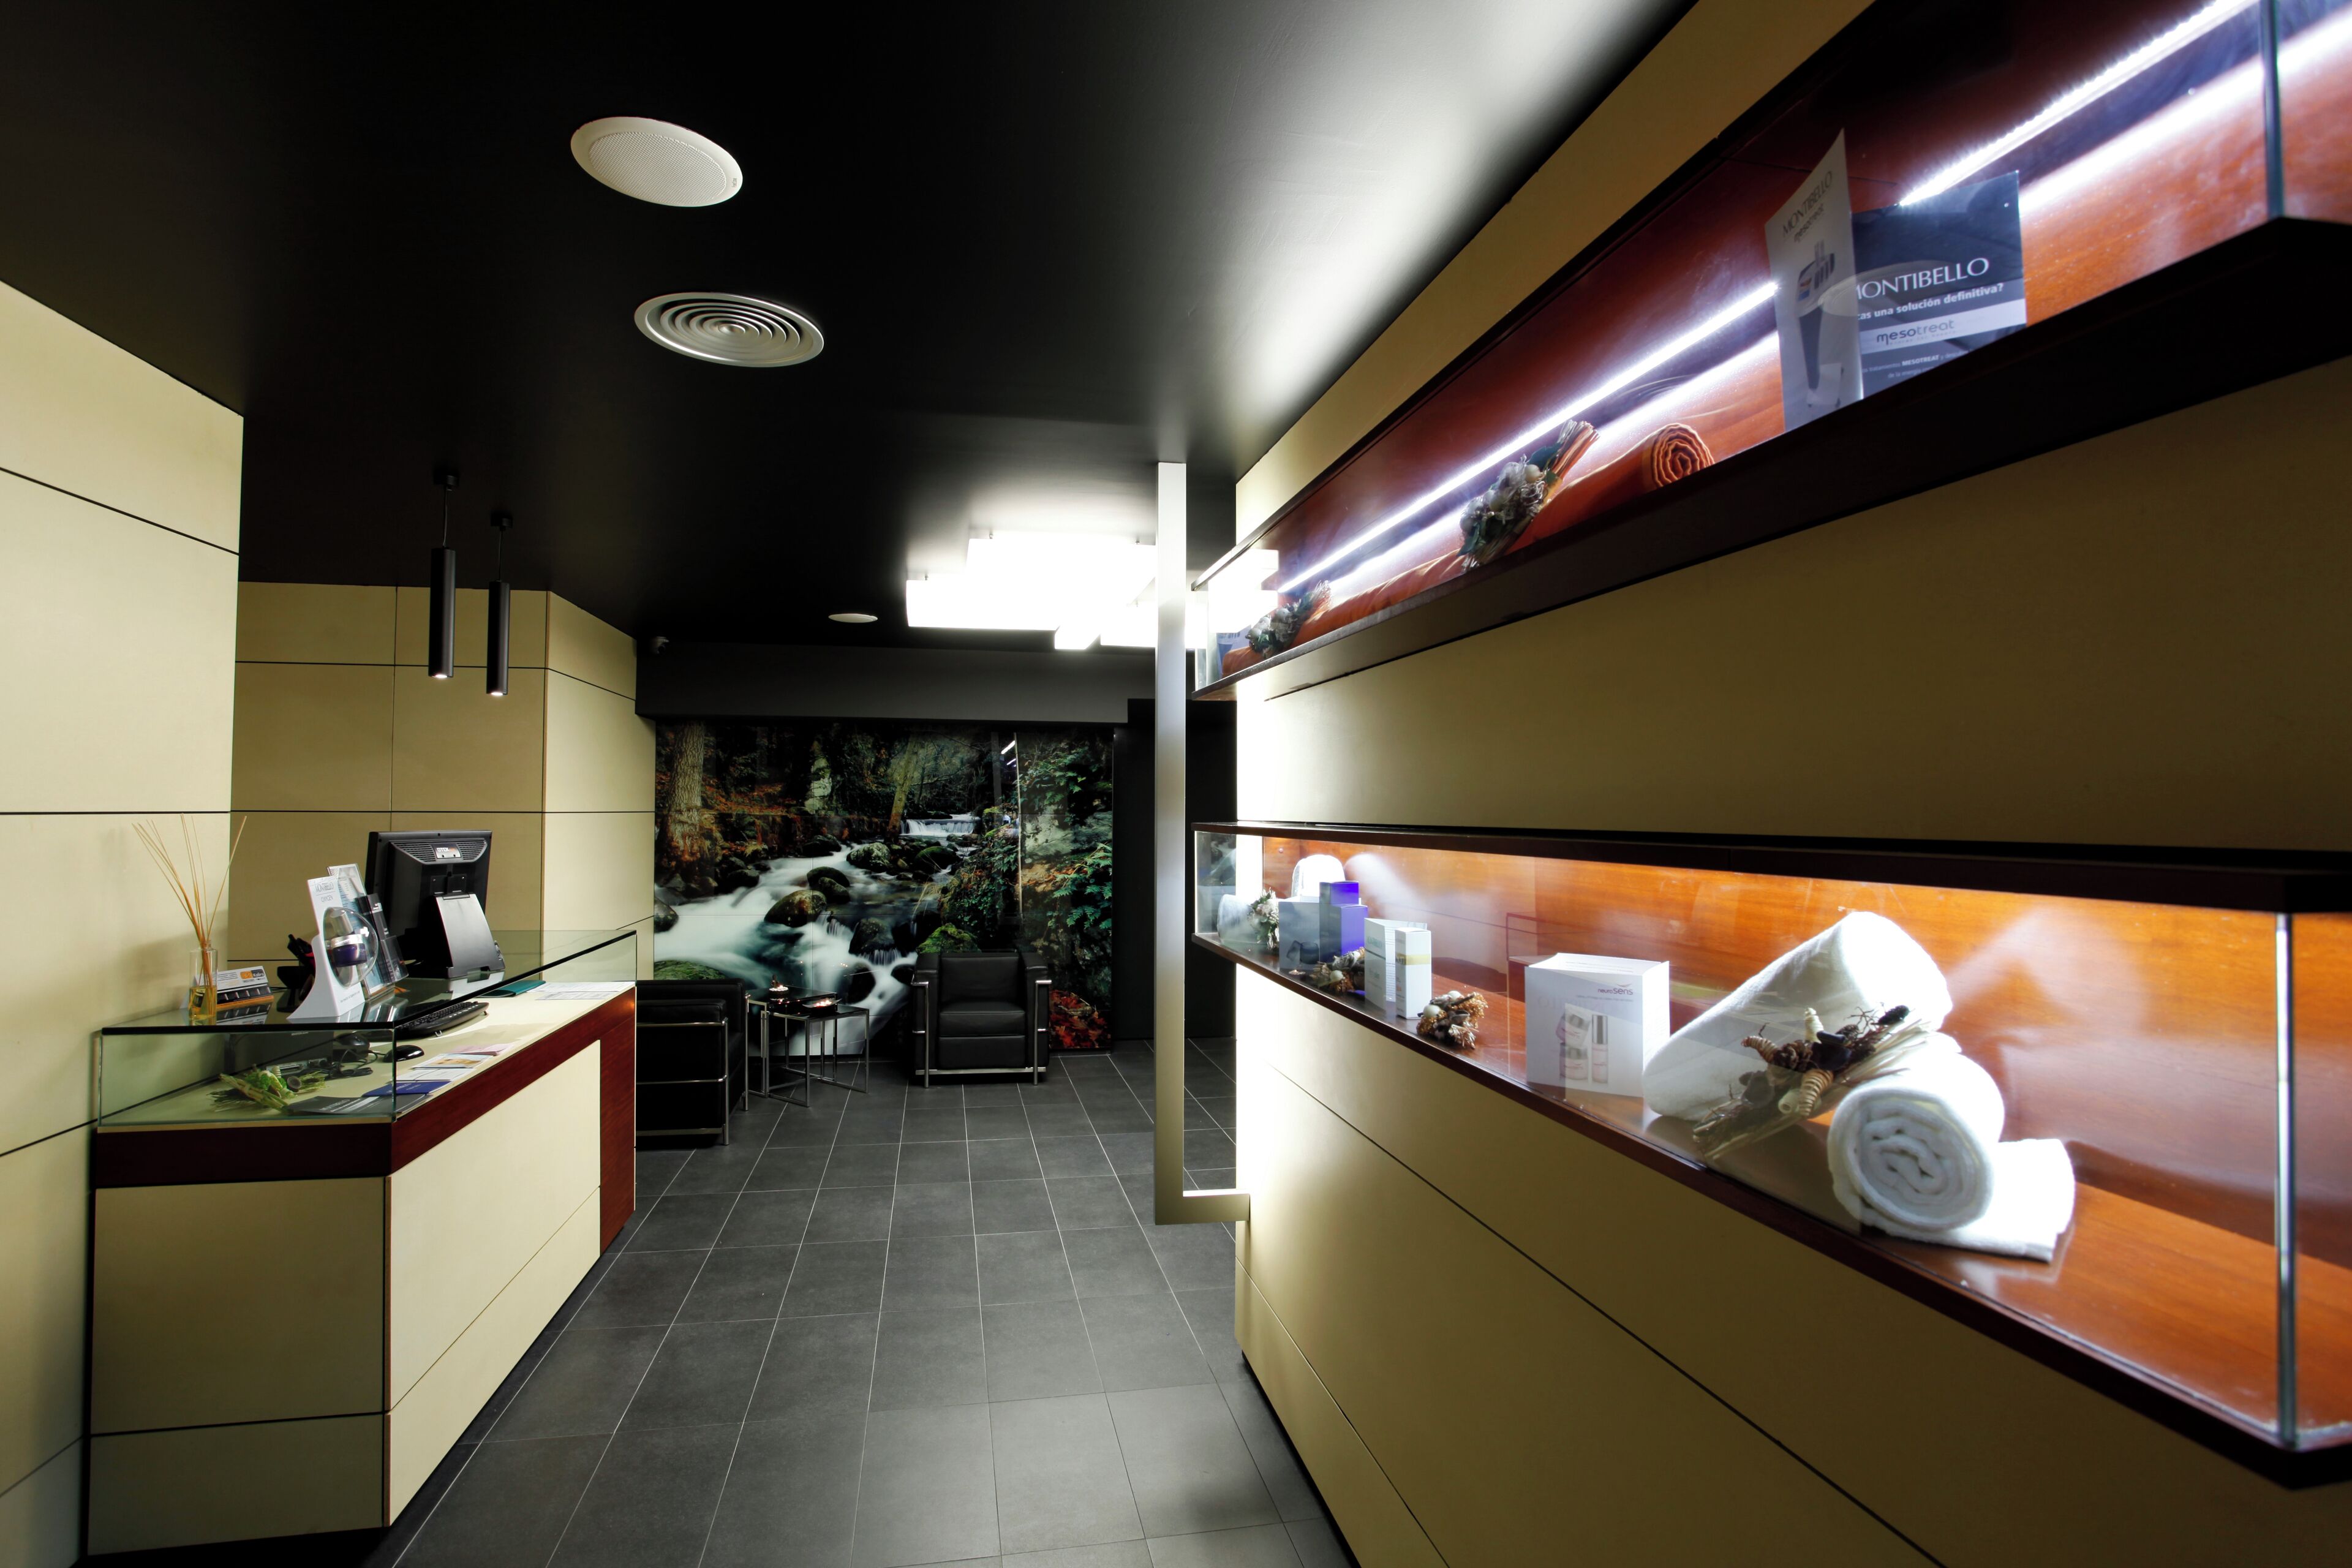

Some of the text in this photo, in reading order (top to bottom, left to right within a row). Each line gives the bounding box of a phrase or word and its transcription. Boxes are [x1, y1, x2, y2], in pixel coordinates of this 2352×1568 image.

[1874, 308, 1894, 317] una
[1896, 298, 1941, 314] solución
[1943, 282, 2003, 304] definitiva?
[1876, 319, 1955, 345] mesotreat
[1902, 354, 1940, 366] MESOTREAT
